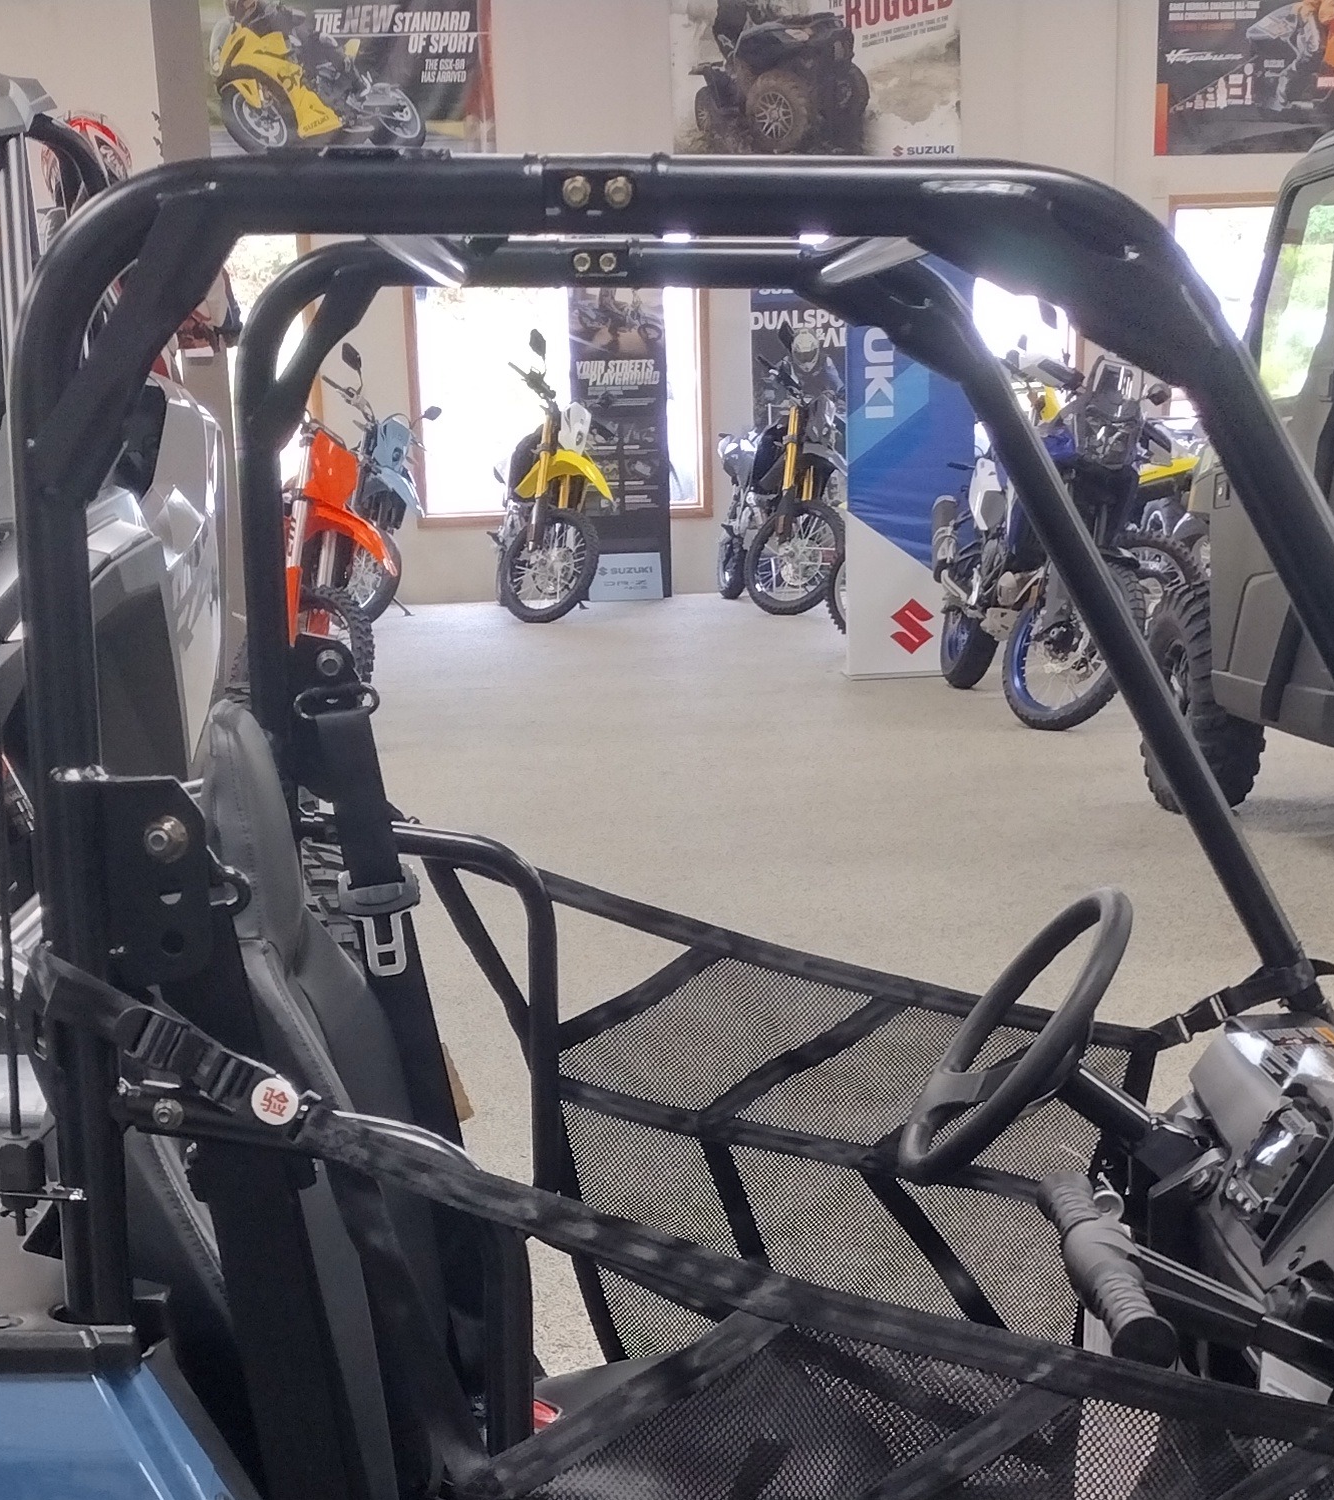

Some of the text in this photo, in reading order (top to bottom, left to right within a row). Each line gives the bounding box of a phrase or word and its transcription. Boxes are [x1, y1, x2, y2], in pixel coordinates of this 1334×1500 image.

[314, 5, 471, 33] THE NEW STANDARD
[846, 0, 952, 29] RUGG
[408, 34, 477, 53] OF SPORT
[425, 58, 439, 71] THE
[421, 70, 467, 83] HAS ARRIVED
[302, 115, 330, 132] SUZUKI
[907, 145, 955, 156] SUZUKI
[575, 359, 655, 375] YOUR STREETS
[588, 370, 661, 386] PLAYGROUND
[610, 566, 654, 575] SUZUKI
[259, 1086, 290, 1118] 验
